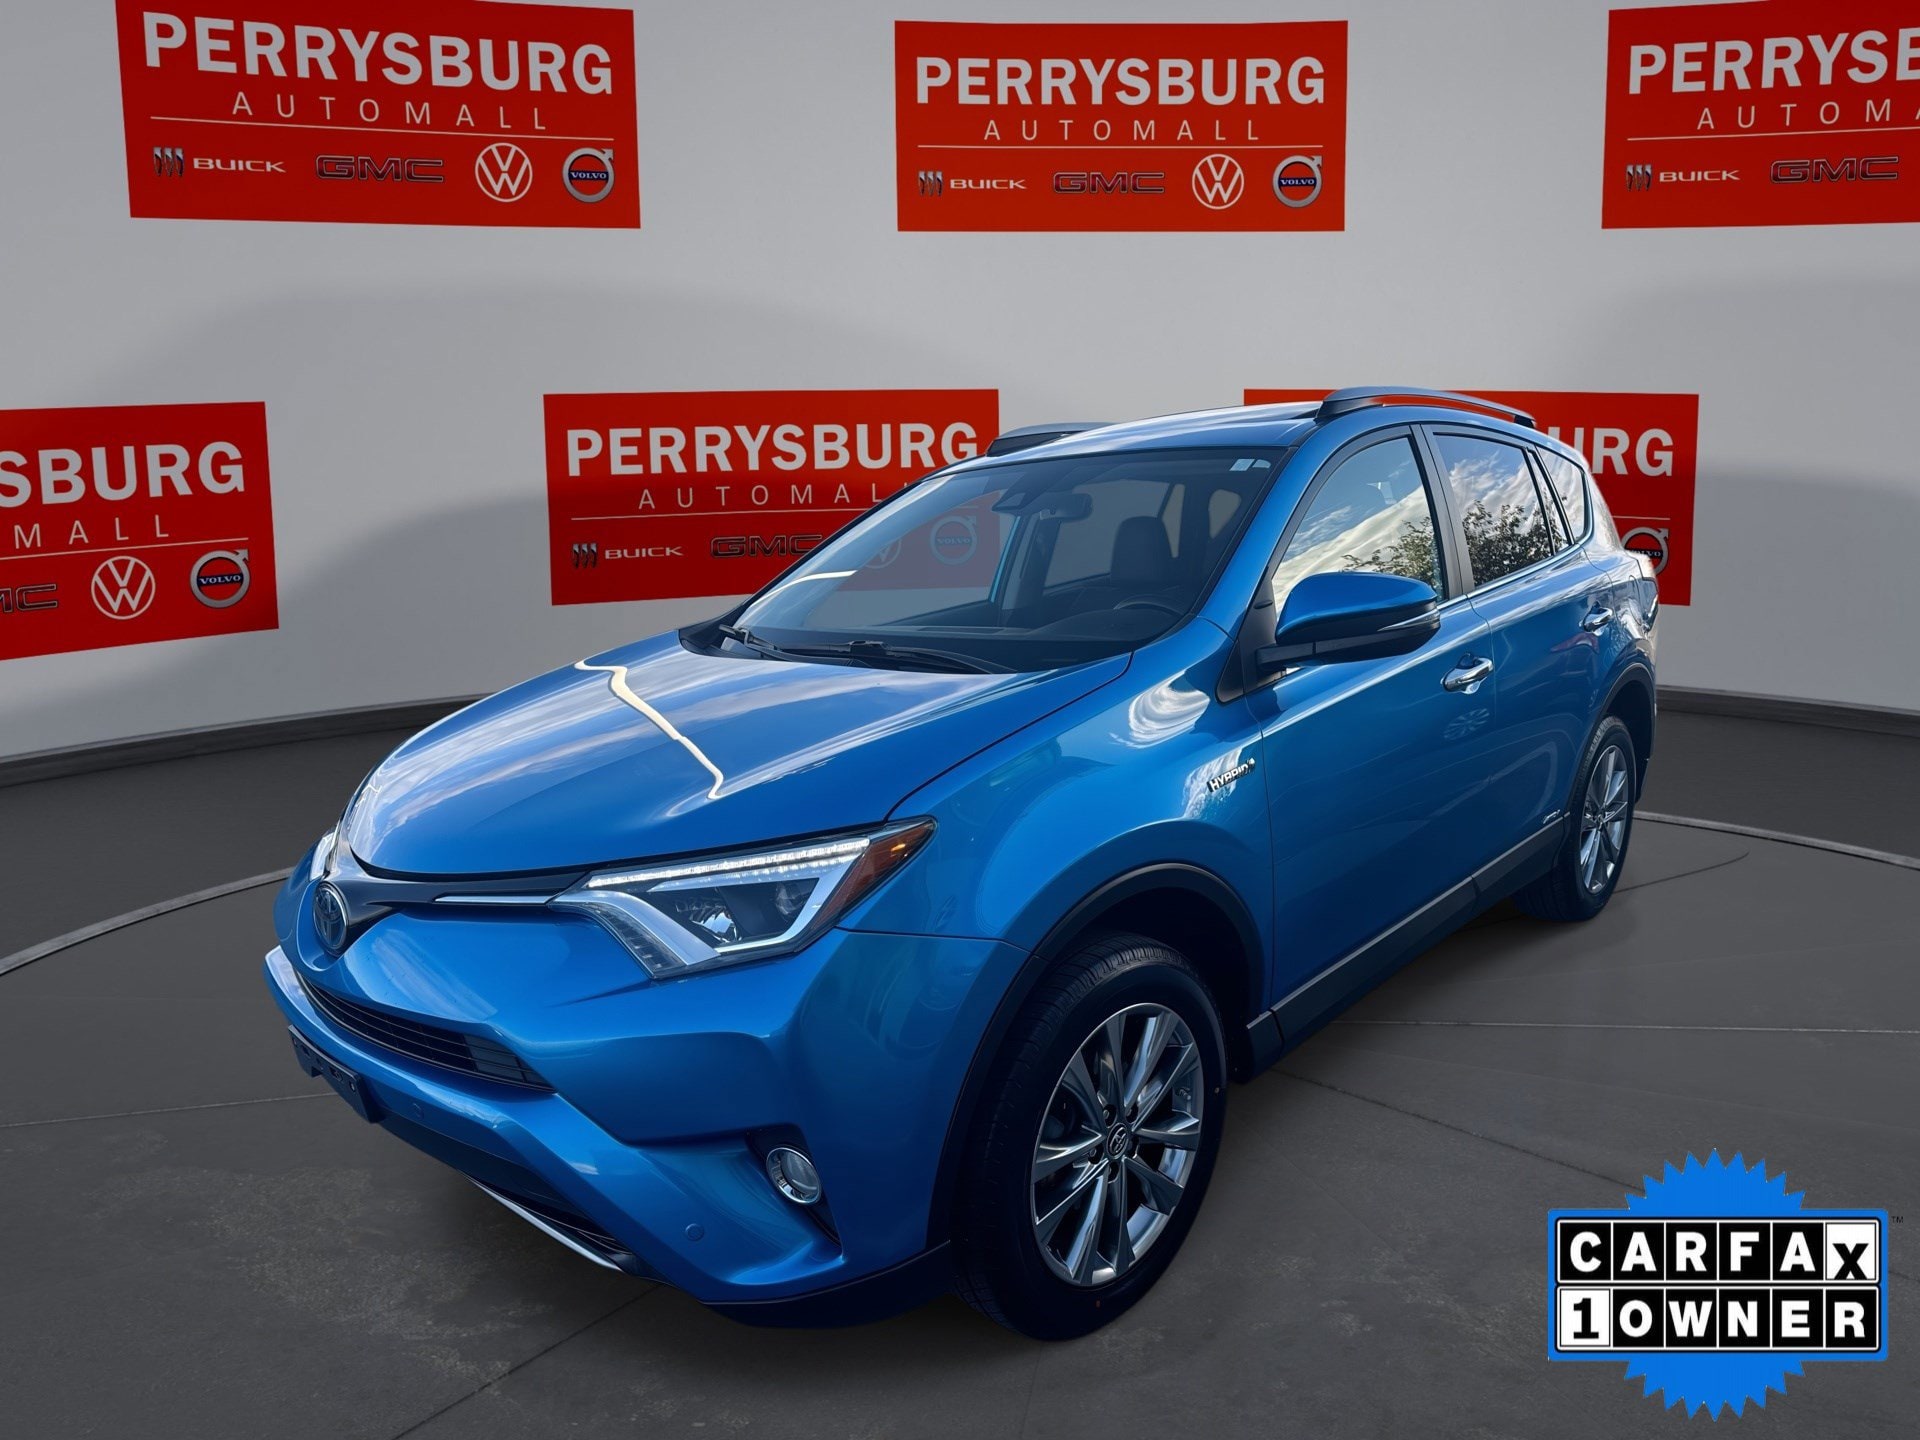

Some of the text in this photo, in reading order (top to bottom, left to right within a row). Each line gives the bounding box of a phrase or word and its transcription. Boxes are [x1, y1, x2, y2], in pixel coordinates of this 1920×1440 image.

[143, 11, 612, 95] PERRYSBURG
[917, 56, 1325, 105] PERRYSBURG
[232, 91, 546, 131] AUTOMALL
[984, 119, 1259, 142] AUTOMALL
[193, 157, 286, 174] BUICK
[315, 154, 444, 183] GMC
[570, 171, 607, 180] VOLVO
[1659, 156, 1899, 184] BUICK GMC
[950, 178, 1026, 190] BUICK
[1053, 171, 1166, 195] GMC
[1280, 177, 1315, 187] VOLVO
[567, 422, 978, 477] PERRYSBURG
[0, 441, 245, 508] SBURG
[638, 482, 908, 510] AUTOMAL
[605, 546, 684, 559] BUICK
[199, 574, 242, 585] VOLVO
